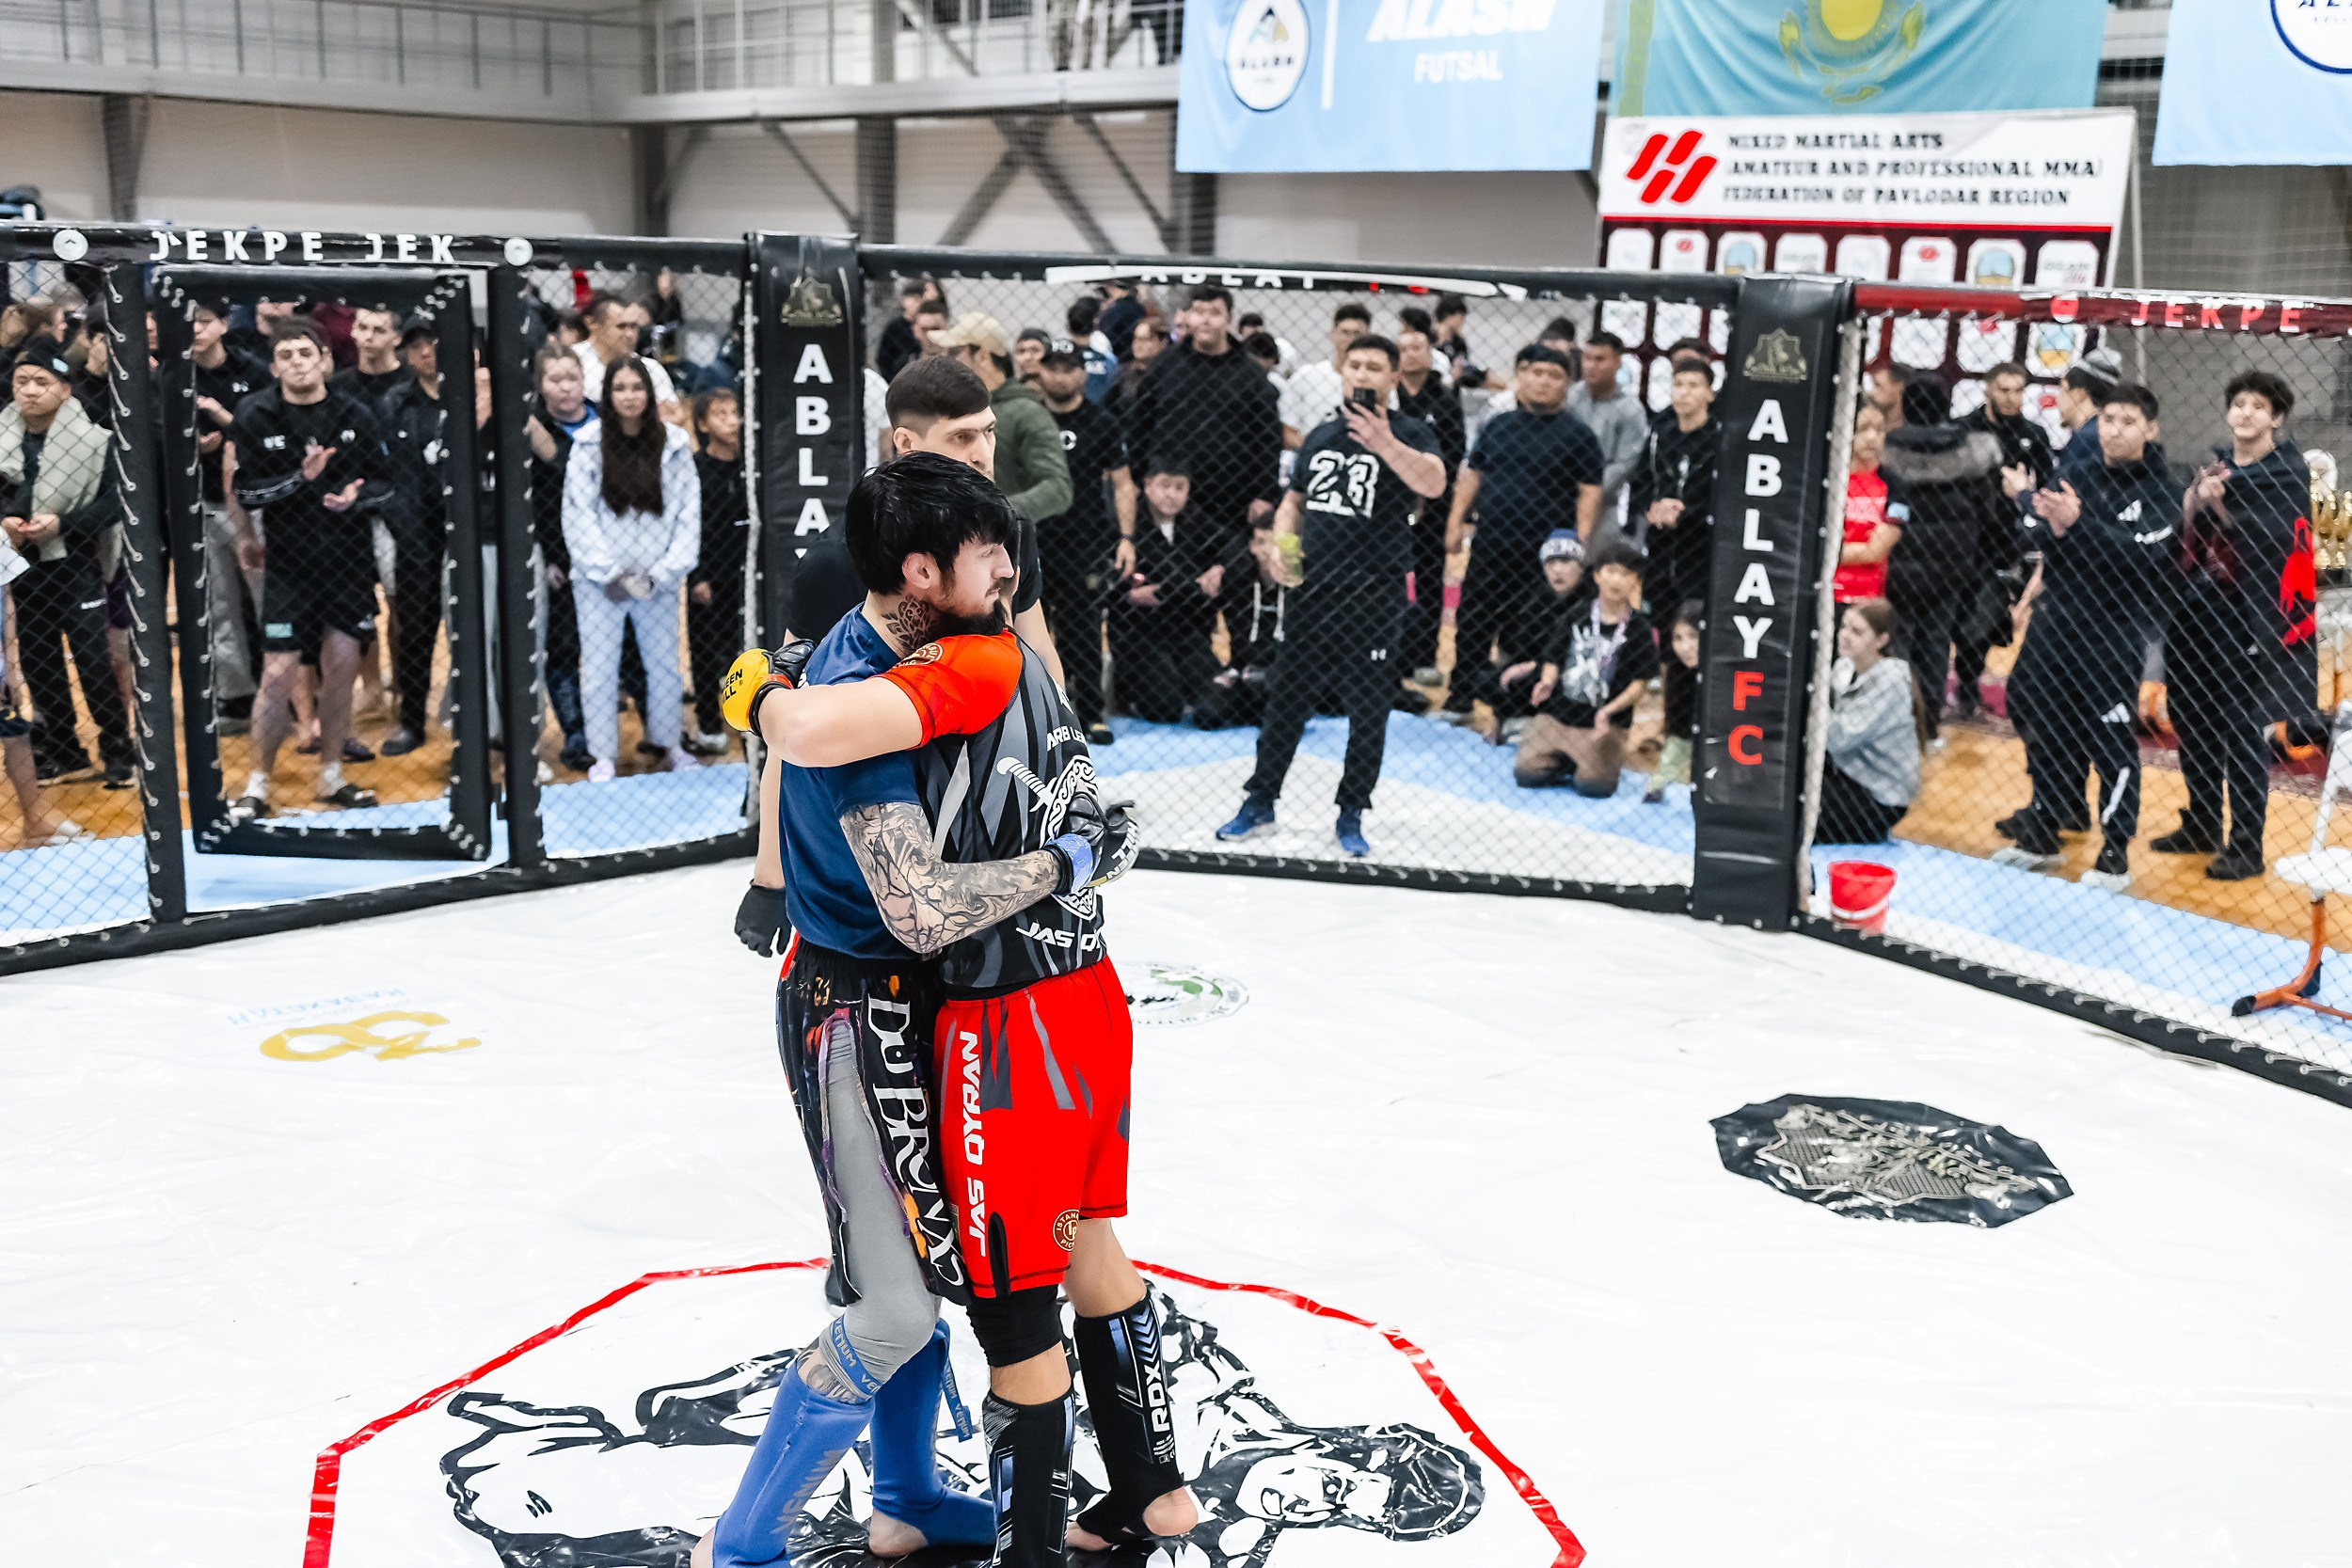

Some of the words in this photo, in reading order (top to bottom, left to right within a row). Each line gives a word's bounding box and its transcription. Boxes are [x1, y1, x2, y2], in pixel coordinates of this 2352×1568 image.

[1414, 50, 1504, 83] FUTSAL
[1729, 134, 1786, 149] MIXED
[1795, 134, 1880, 149] MARTIAL
[1891, 134, 1943, 149] ARTS
[1828, 161, 1868, 176] AND
[1877, 161, 2034, 177] PROFESSIONAL
[1724, 187, 1834, 202] FEDERATION
[1842, 188, 1866, 203] OF
[1874, 188, 1979, 204] PAVLODAR
[1990, 189, 2070, 205] REGION
[150, 230, 324, 261] JEKPE
[365, 232, 455, 263] JEK
[2131, 294, 2305, 333] JEKPE
[793, 343, 834, 559] ABLA
[1306, 450, 1380, 518] 23
[1733, 399, 1788, 658] ABLAY
[1728, 672, 1765, 765] FC
[1046, 725, 1071, 752] ARB
[1015, 923, 1075, 949] JAS
[960, 1030, 986, 1165] QYRAN
[967, 1177, 986, 1257] JAS
[834, 1316, 858, 1368] VENUM
[1143, 1359, 1170, 1433] RDX
[954, 1402, 971, 1439] VENUM
